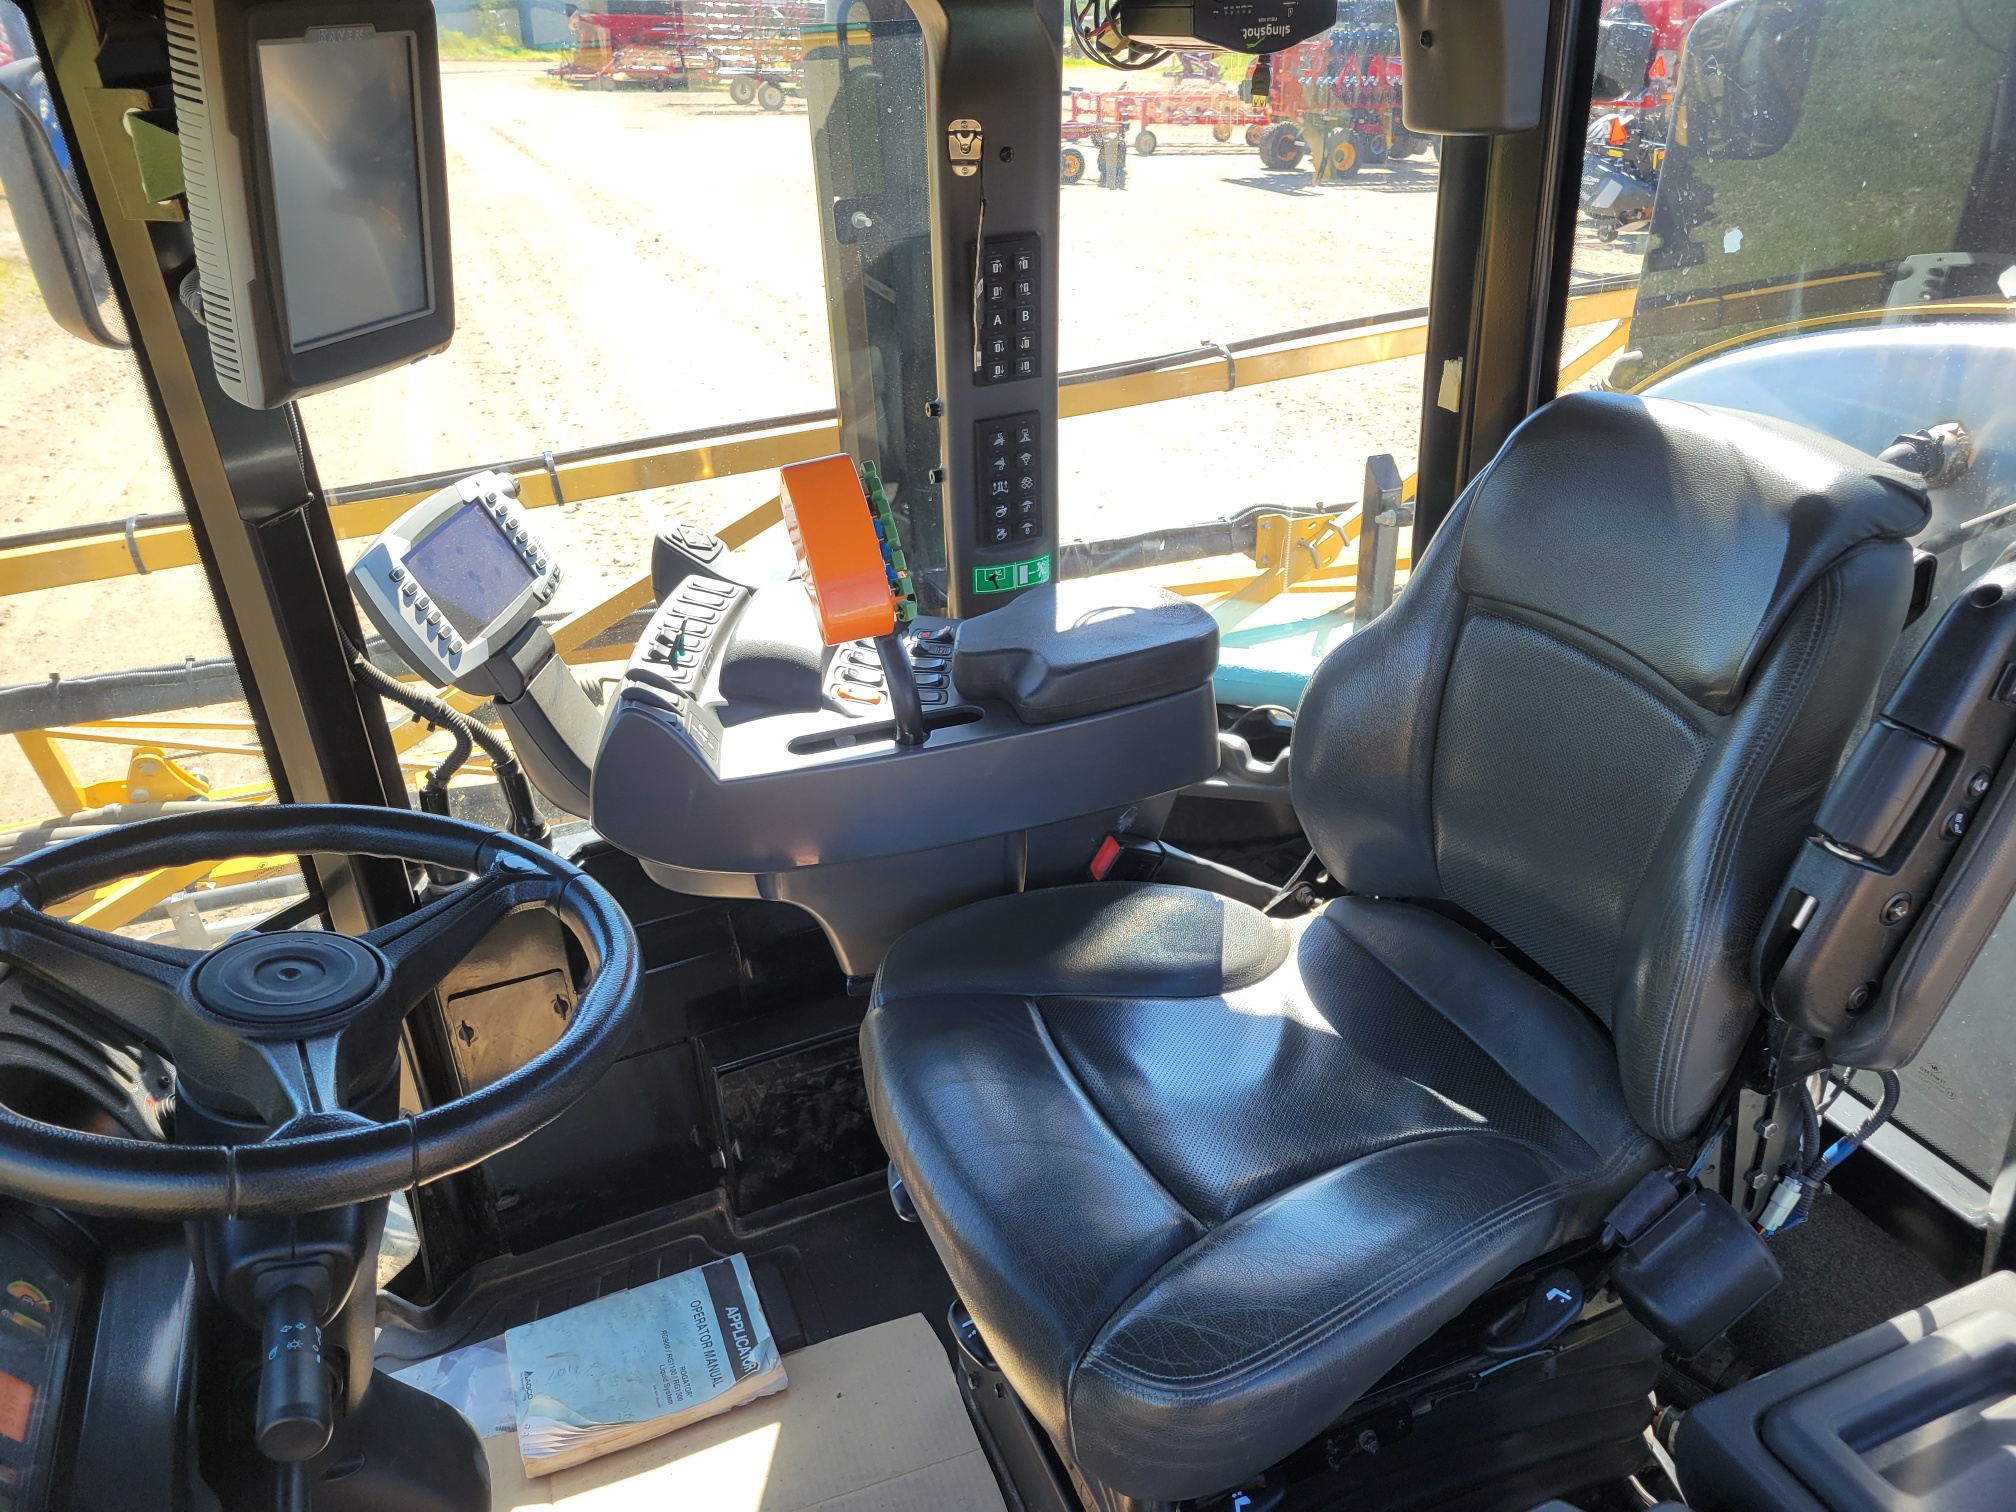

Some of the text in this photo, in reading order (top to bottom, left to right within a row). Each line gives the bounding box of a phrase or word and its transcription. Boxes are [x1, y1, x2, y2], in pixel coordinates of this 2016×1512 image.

[1241, 24, 1291, 39] slingshot
[993, 310, 1030, 326] A B
[690, 1299, 724, 1388] OPERATOR MANUAL
[725, 1306, 757, 1373] APPLICATOR
[525, 1376, 534, 1400] AGCO
[659, 1364, 674, 1405] Liquid System
